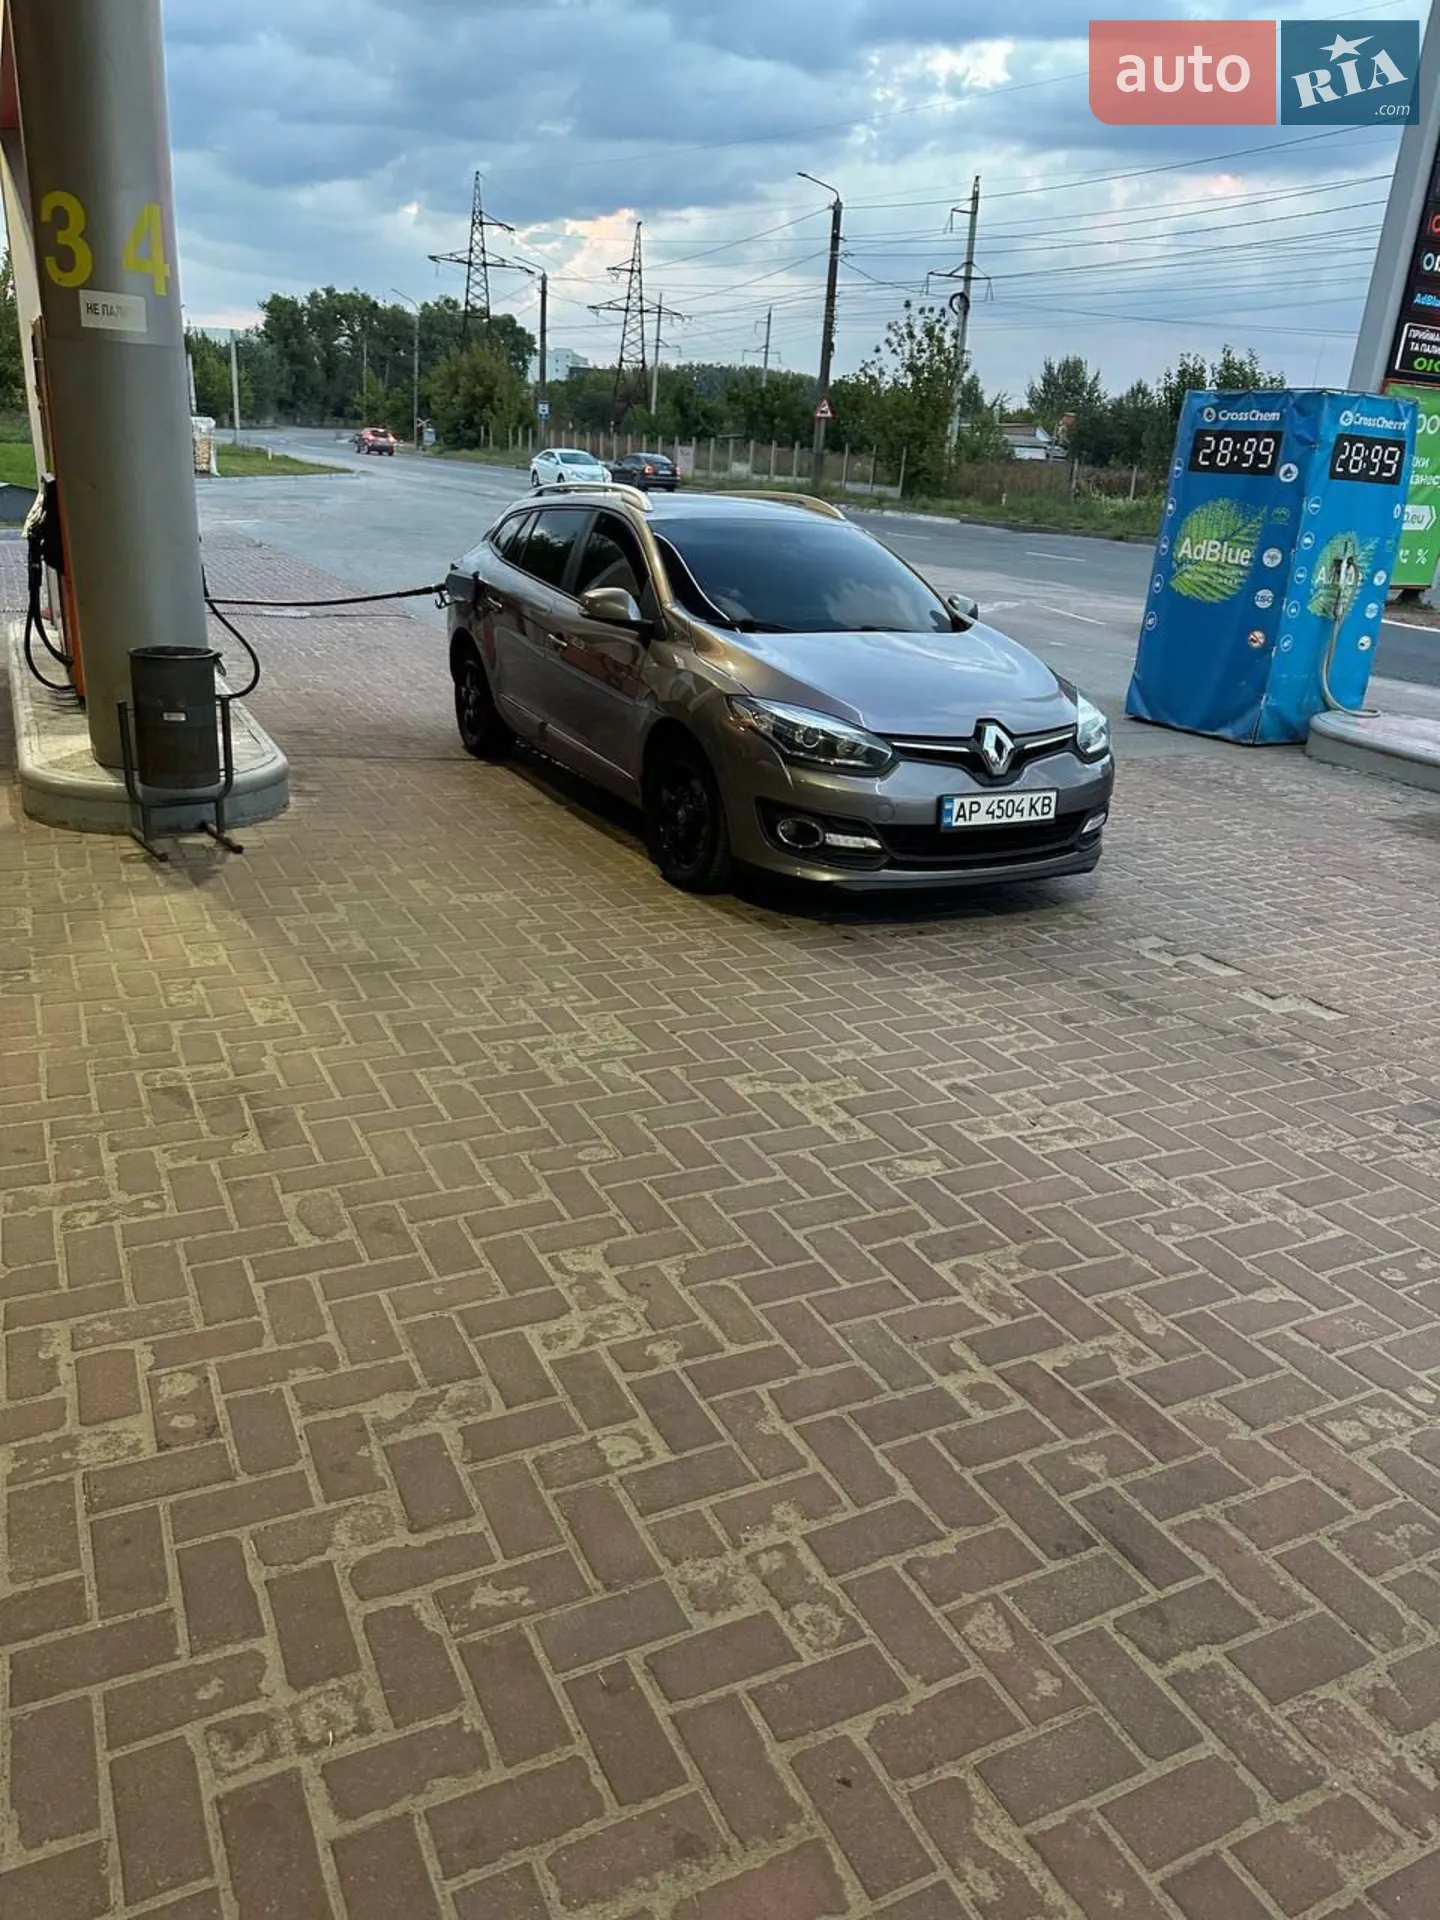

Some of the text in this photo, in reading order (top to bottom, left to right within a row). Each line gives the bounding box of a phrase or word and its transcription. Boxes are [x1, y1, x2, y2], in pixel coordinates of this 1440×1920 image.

[41, 190, 170, 296] 3 4
[86, 302, 128, 318] НЕ ПАЛ
[1218, 409, 1280, 421] CrossChem
[1354, 413, 1406, 431] CrossChem
[1198, 436, 1275, 468] 28:99
[1335, 441, 1400, 477] 28:99
[1178, 536, 1252, 567] AdBlue
[955, 796, 1052, 822] AP 4504 KB
